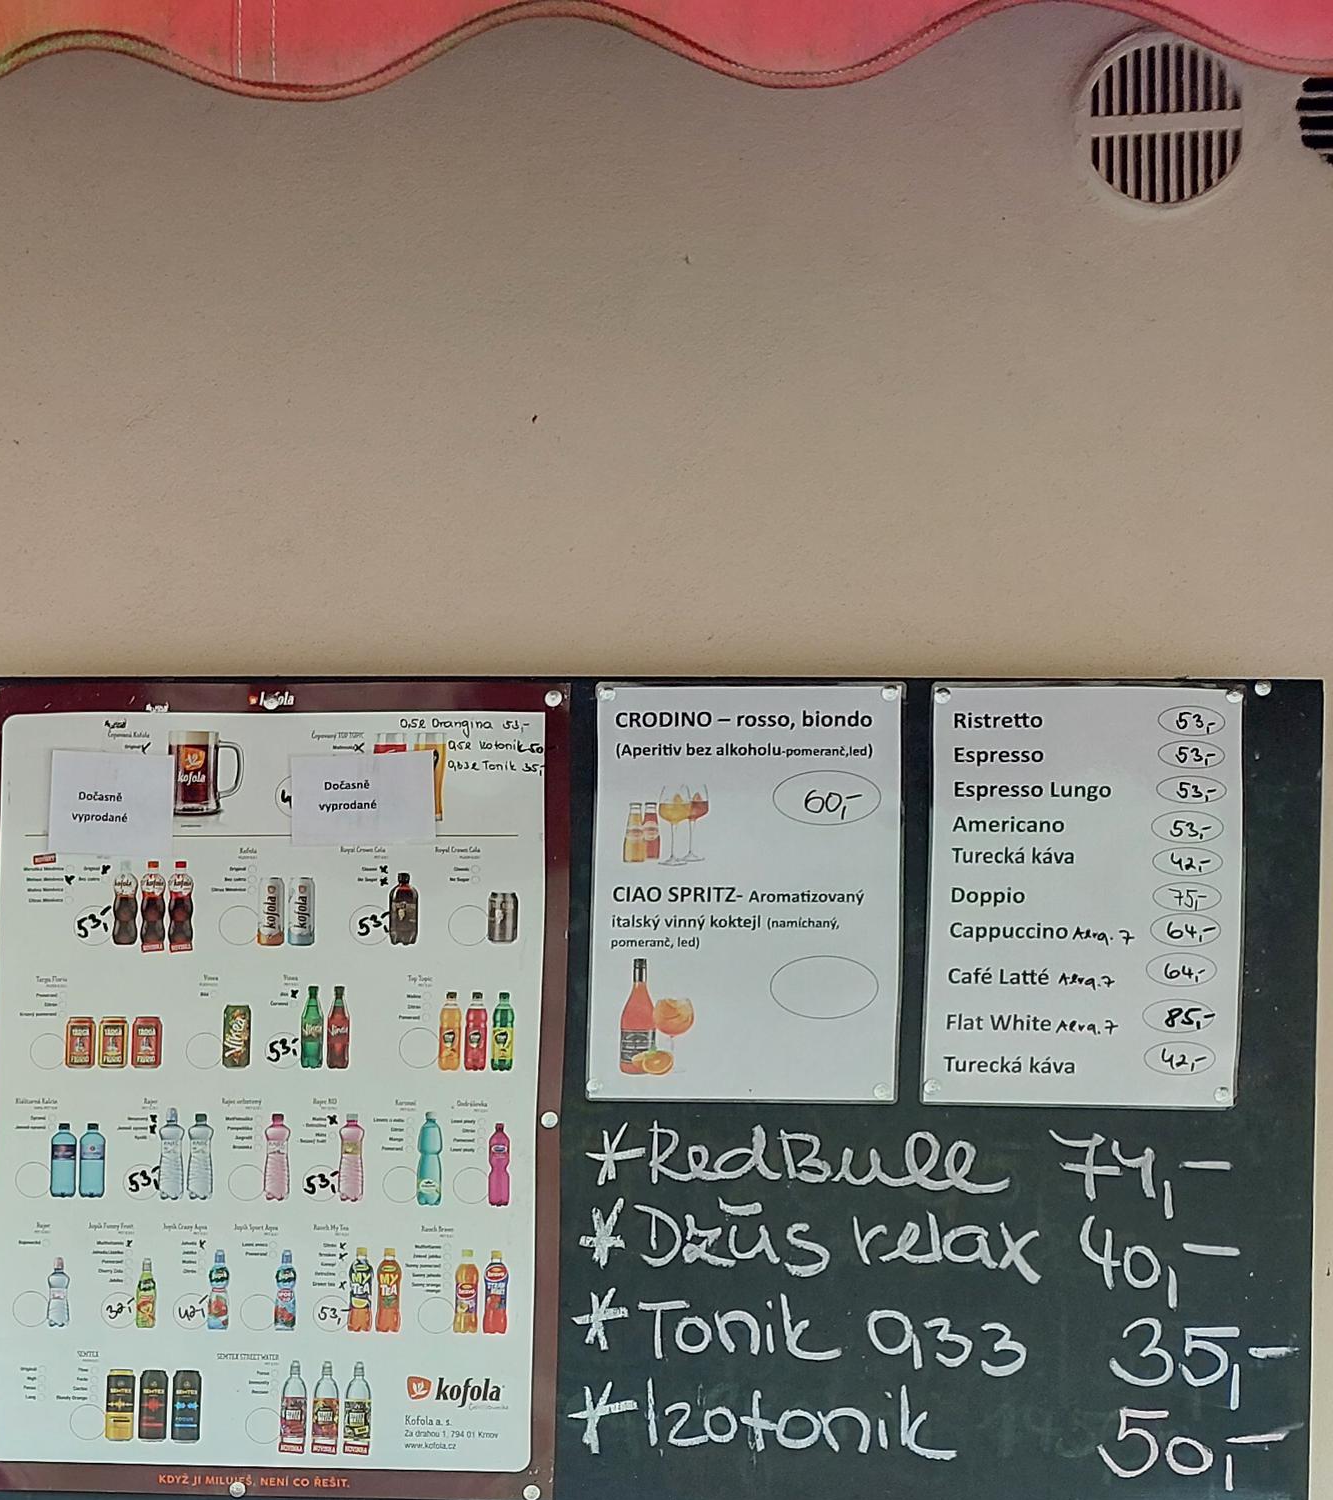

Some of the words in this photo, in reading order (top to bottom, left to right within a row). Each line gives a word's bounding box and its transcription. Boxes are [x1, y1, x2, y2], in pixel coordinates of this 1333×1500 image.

[431, 718, 493, 738] Orangina
[615, 712, 712, 728] CRODINO
[737, 712, 796, 730] rosso,
[802, 711, 873, 728] biondo
[954, 712, 1043, 729] Ristretto
[1176, 712, 1215, 735] 53,-
[616, 743, 682, 758] (Aperitiv
[686, 744, 712, 757] bez
[954, 748, 1044, 765] Espresso
[1175, 747, 1215, 766] 53,-
[482, 760, 516, 772] Tonik
[177, 770, 206, 789] kofola
[324, 779, 370, 792] Dočasně
[78, 792, 123, 802] Dočasně
[954, 782, 1044, 800] Espresso
[1050, 782, 1111, 801] Lungo
[1176, 782, 1217, 802] 53,-
[319, 800, 377, 812] vyprodané
[804, 789, 862, 820] 60,-
[72, 812, 128, 824] vyprodané
[952, 816, 1065, 833] Americano
[1170, 820, 1212, 839] 53,-
[952, 847, 1024, 864] Turecká
[1032, 847, 1074, 864] káva
[1170, 852, 1211, 872] 42,-
[612, 886, 662, 903] CIAO
[668, 886, 743, 903] SPRITZ-
[749, 889, 864, 906] Aromatizovaný
[951, 887, 1025, 907] Doppio
[1168, 888, 1207, 910] 75,-
[264, 896, 280, 929] kofola
[294, 896, 311, 929] kofola
[611, 915, 659, 931] italský
[664, 915, 705, 931] vinný
[710, 914, 761, 931] koktejl
[767, 917, 840, 931] (namíchaný,
[950, 922, 1068, 940] Cappuccino
[1166, 921, 1216, 941] 64,-
[611, 936, 674, 950] pomeranč,
[677, 936, 700, 949] led)
[948, 968, 992, 985] Café
[999, 968, 1050, 985] Latté
[1164, 964, 1206, 982] 64,-
[946, 1014, 983, 1031] Flat
[991, 1014, 1051, 1031] White
[1164, 1007, 1215, 1029] 85,-
[225, 1017, 245, 1058] Vinea
[944, 1056, 1021, 1073] Turecká
[1029, 1056, 1075, 1074] káva
[1161, 1047, 1207, 1071] 42,-
[852, 1210, 1043, 1285] relax
[1079, 1215, 1241, 1309] 40,-
[352, 1274, 371, 1286] MY
[380, 1274, 398, 1286] MY
[352, 1285, 371, 1295] TEA
[380, 1285, 398, 1296] TEA
[318, 1306, 351, 1325] 53,-
[638, 1292, 842, 1361] Tonik
[1109, 1317, 1299, 1411] 35,-
[435, 1377, 501, 1408] kofola
[405, 1416, 431, 1427] Kofola
[415, 1430, 440, 1438] drahou
[451, 1430, 463, 1438] 794
[646, 1377, 958, 1462] Izotonik
[1097, 1408, 1304, 1492] 50,-
[405, 1442, 456, 1450] www.kofola.cz
[159, 1473, 189, 1485] KDYŽ
[192, 1475, 202, 1486] JI
[260, 1476, 289, 1488] NENÍ
[293, 1478, 309, 1488] CO
[314, 1476, 350, 1488] ŘEŠIT.
